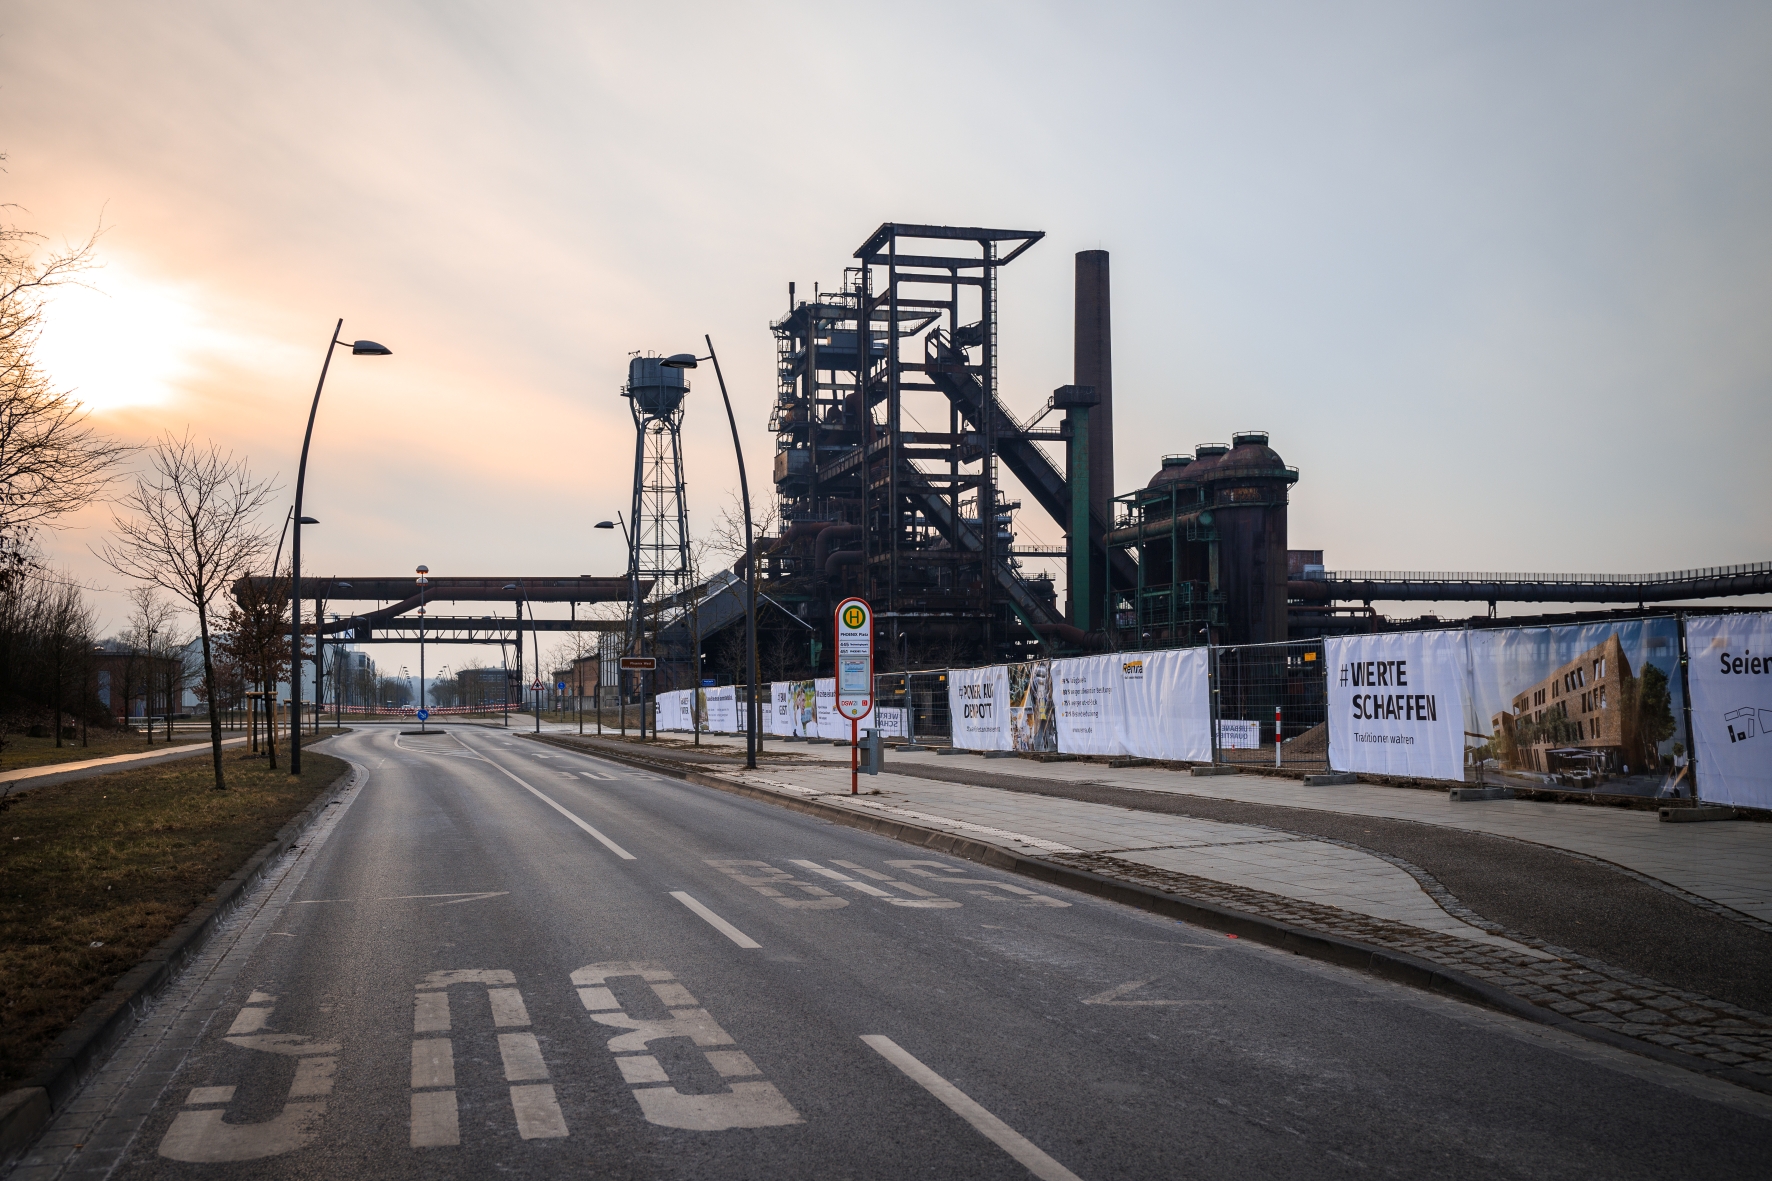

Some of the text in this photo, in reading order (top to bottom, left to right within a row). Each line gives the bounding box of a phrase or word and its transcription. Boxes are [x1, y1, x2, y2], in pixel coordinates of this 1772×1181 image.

[850, 611, 859, 624] H
[1352, 694, 1437, 721] SCHAFFEN
[701, 859, 1073, 910] BUS
